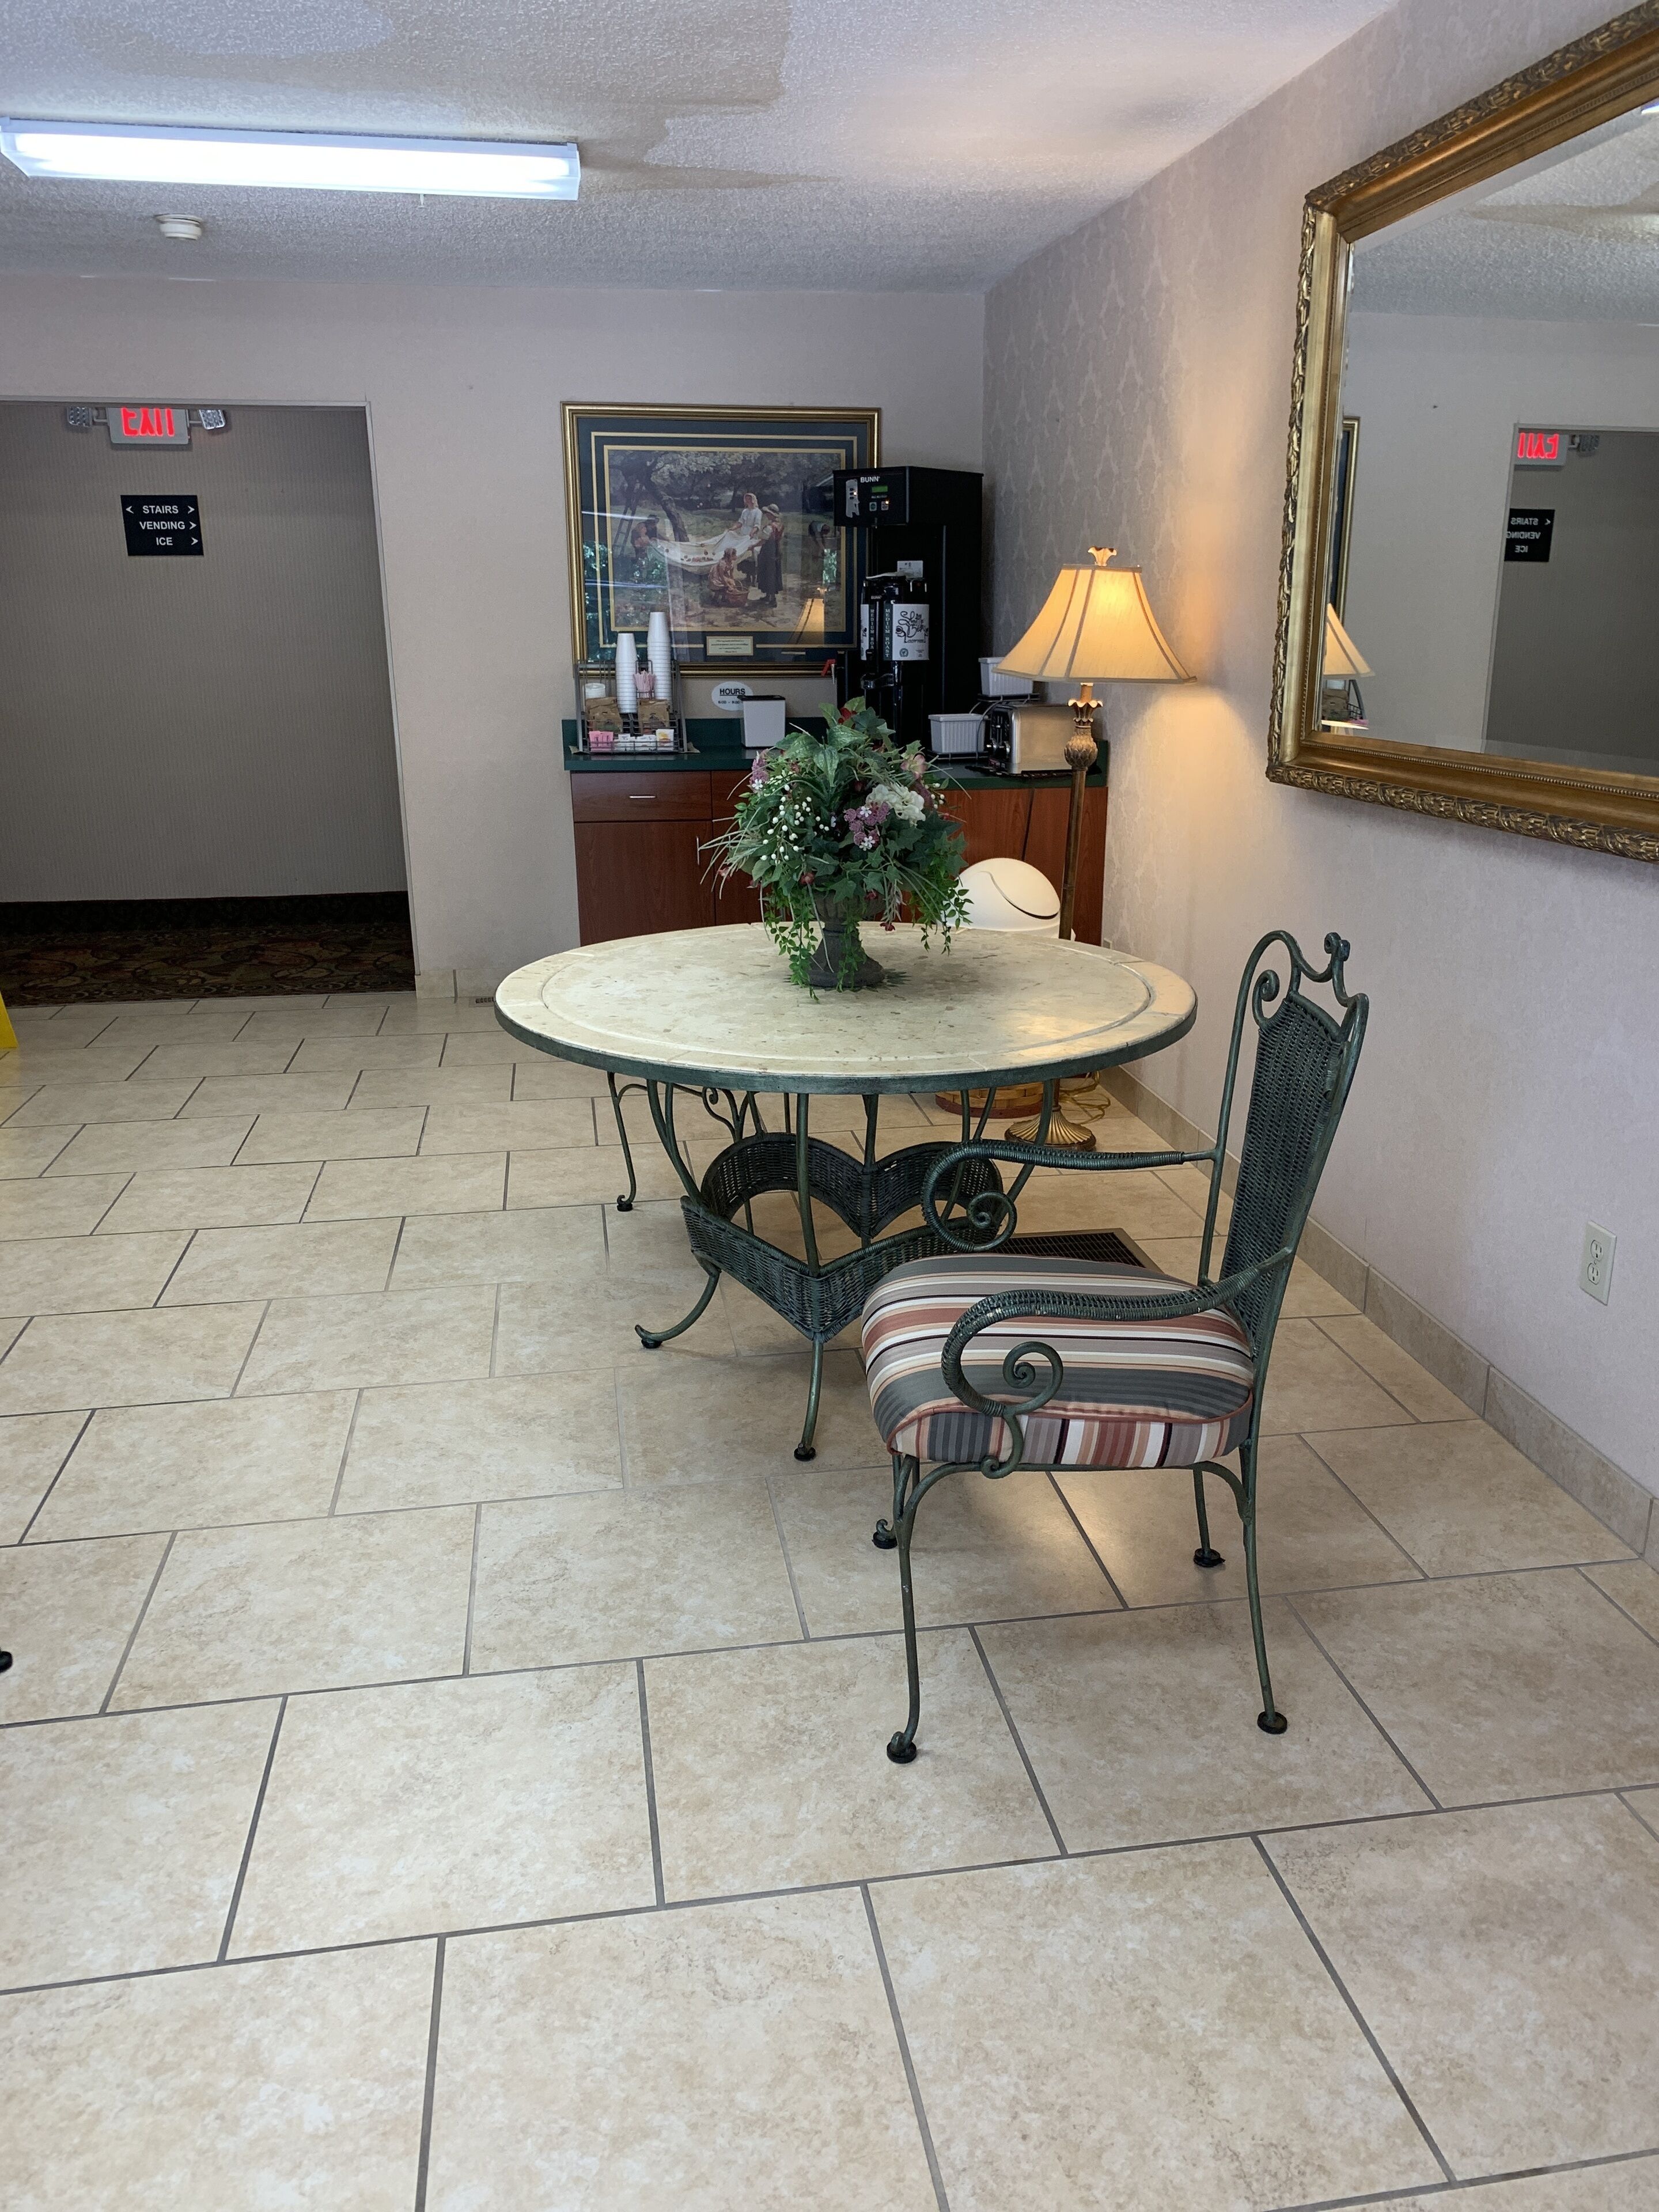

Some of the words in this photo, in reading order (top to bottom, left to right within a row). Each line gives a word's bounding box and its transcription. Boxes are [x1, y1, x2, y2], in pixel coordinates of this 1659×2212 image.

[142, 505, 179, 514] STAIRS
[139, 521, 185, 530] VENDING
[156, 537, 173, 546] ICE
